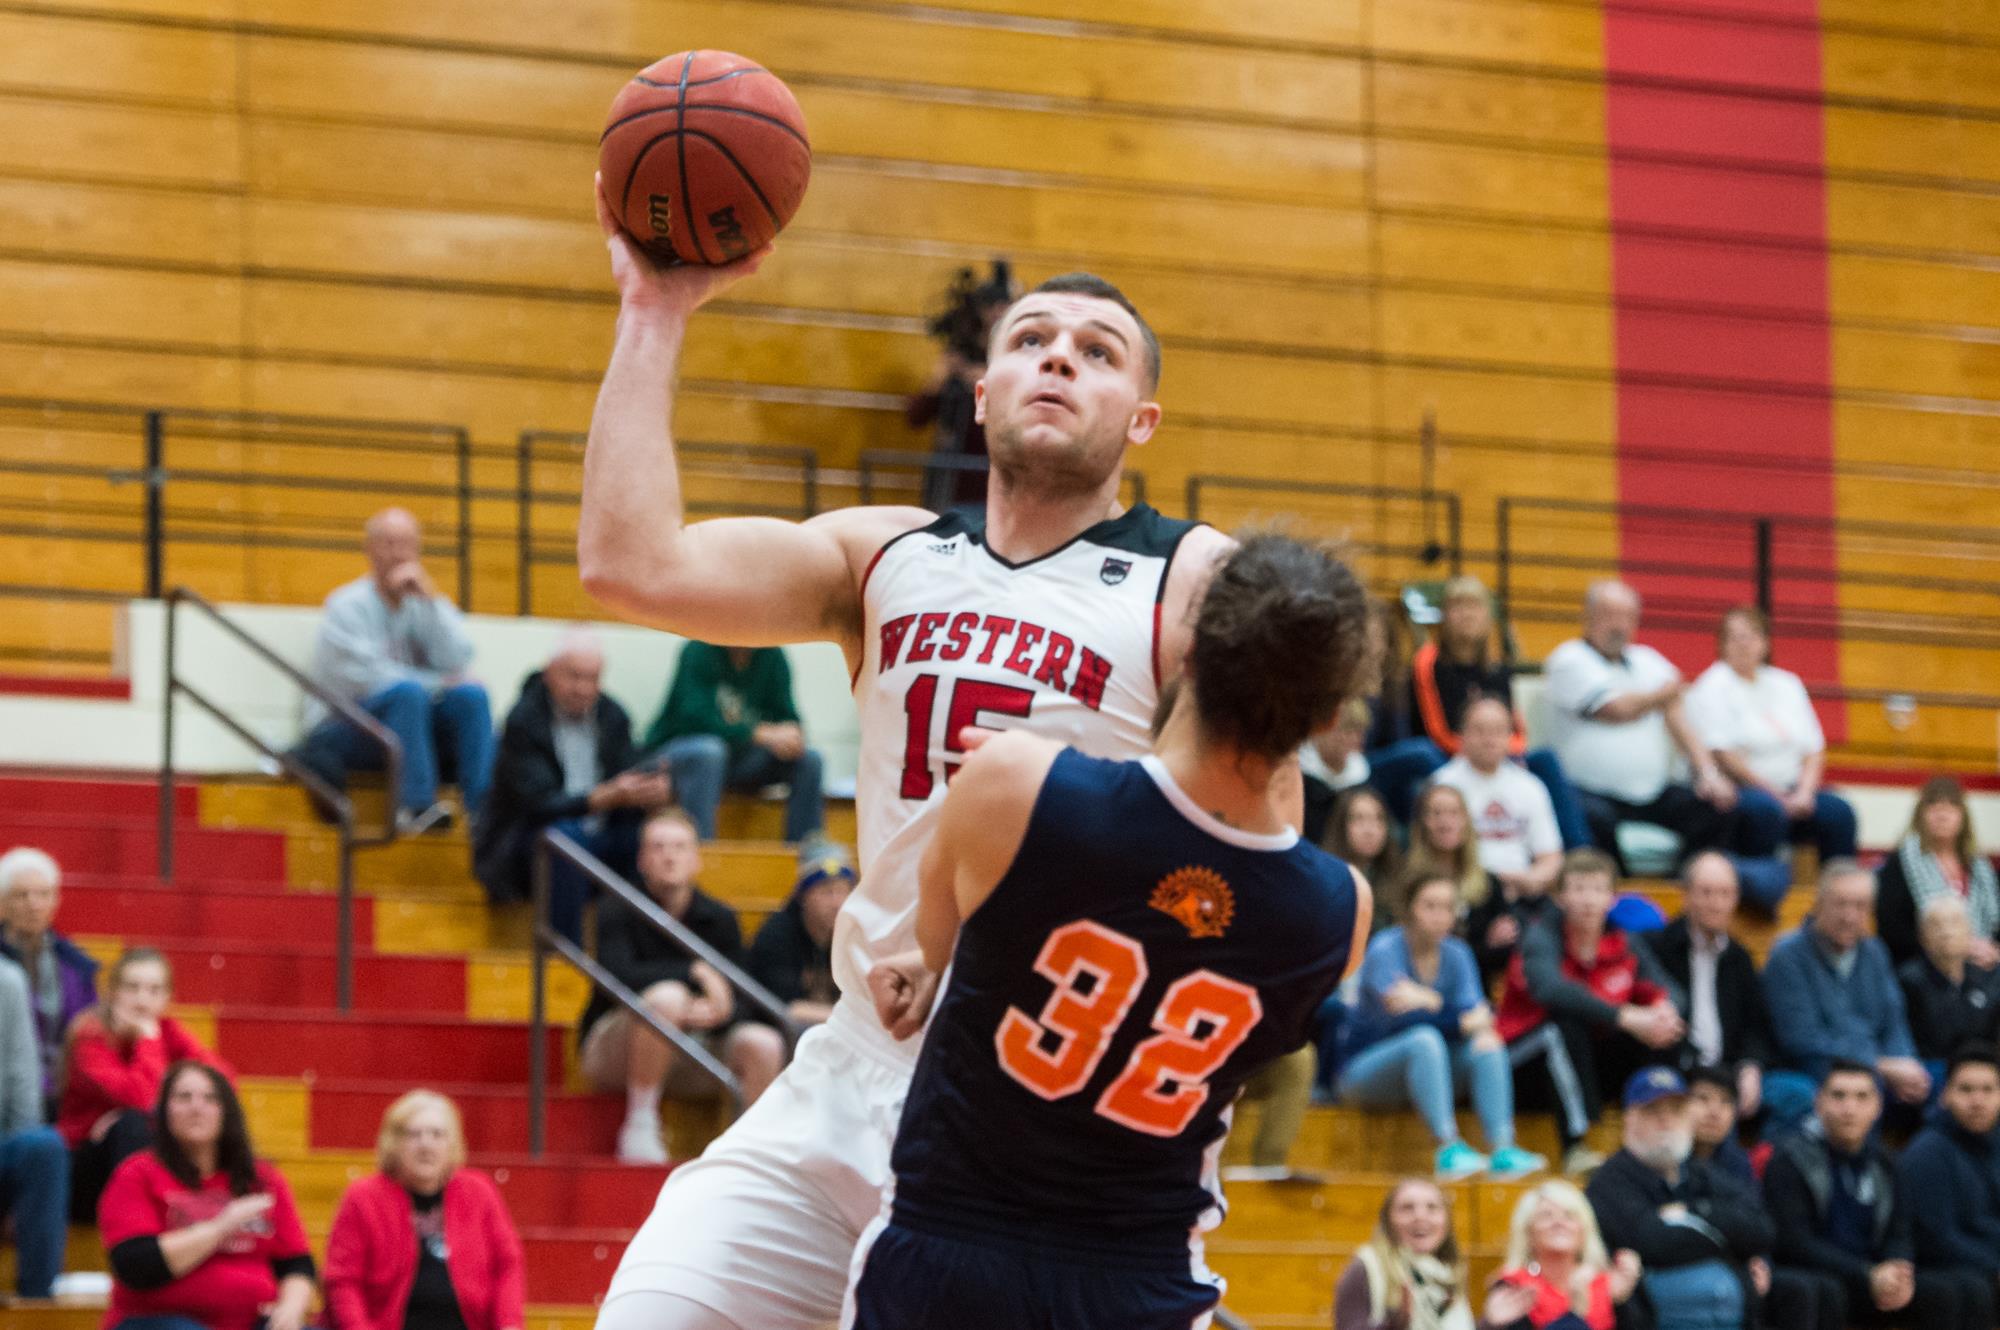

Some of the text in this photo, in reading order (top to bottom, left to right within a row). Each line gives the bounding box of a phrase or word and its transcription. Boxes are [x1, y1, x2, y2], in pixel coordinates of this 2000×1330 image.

[879, 611, 1113, 712] WESTERN
[900, 673, 1036, 800] 15
[994, 918, 1264, 1138] 32
